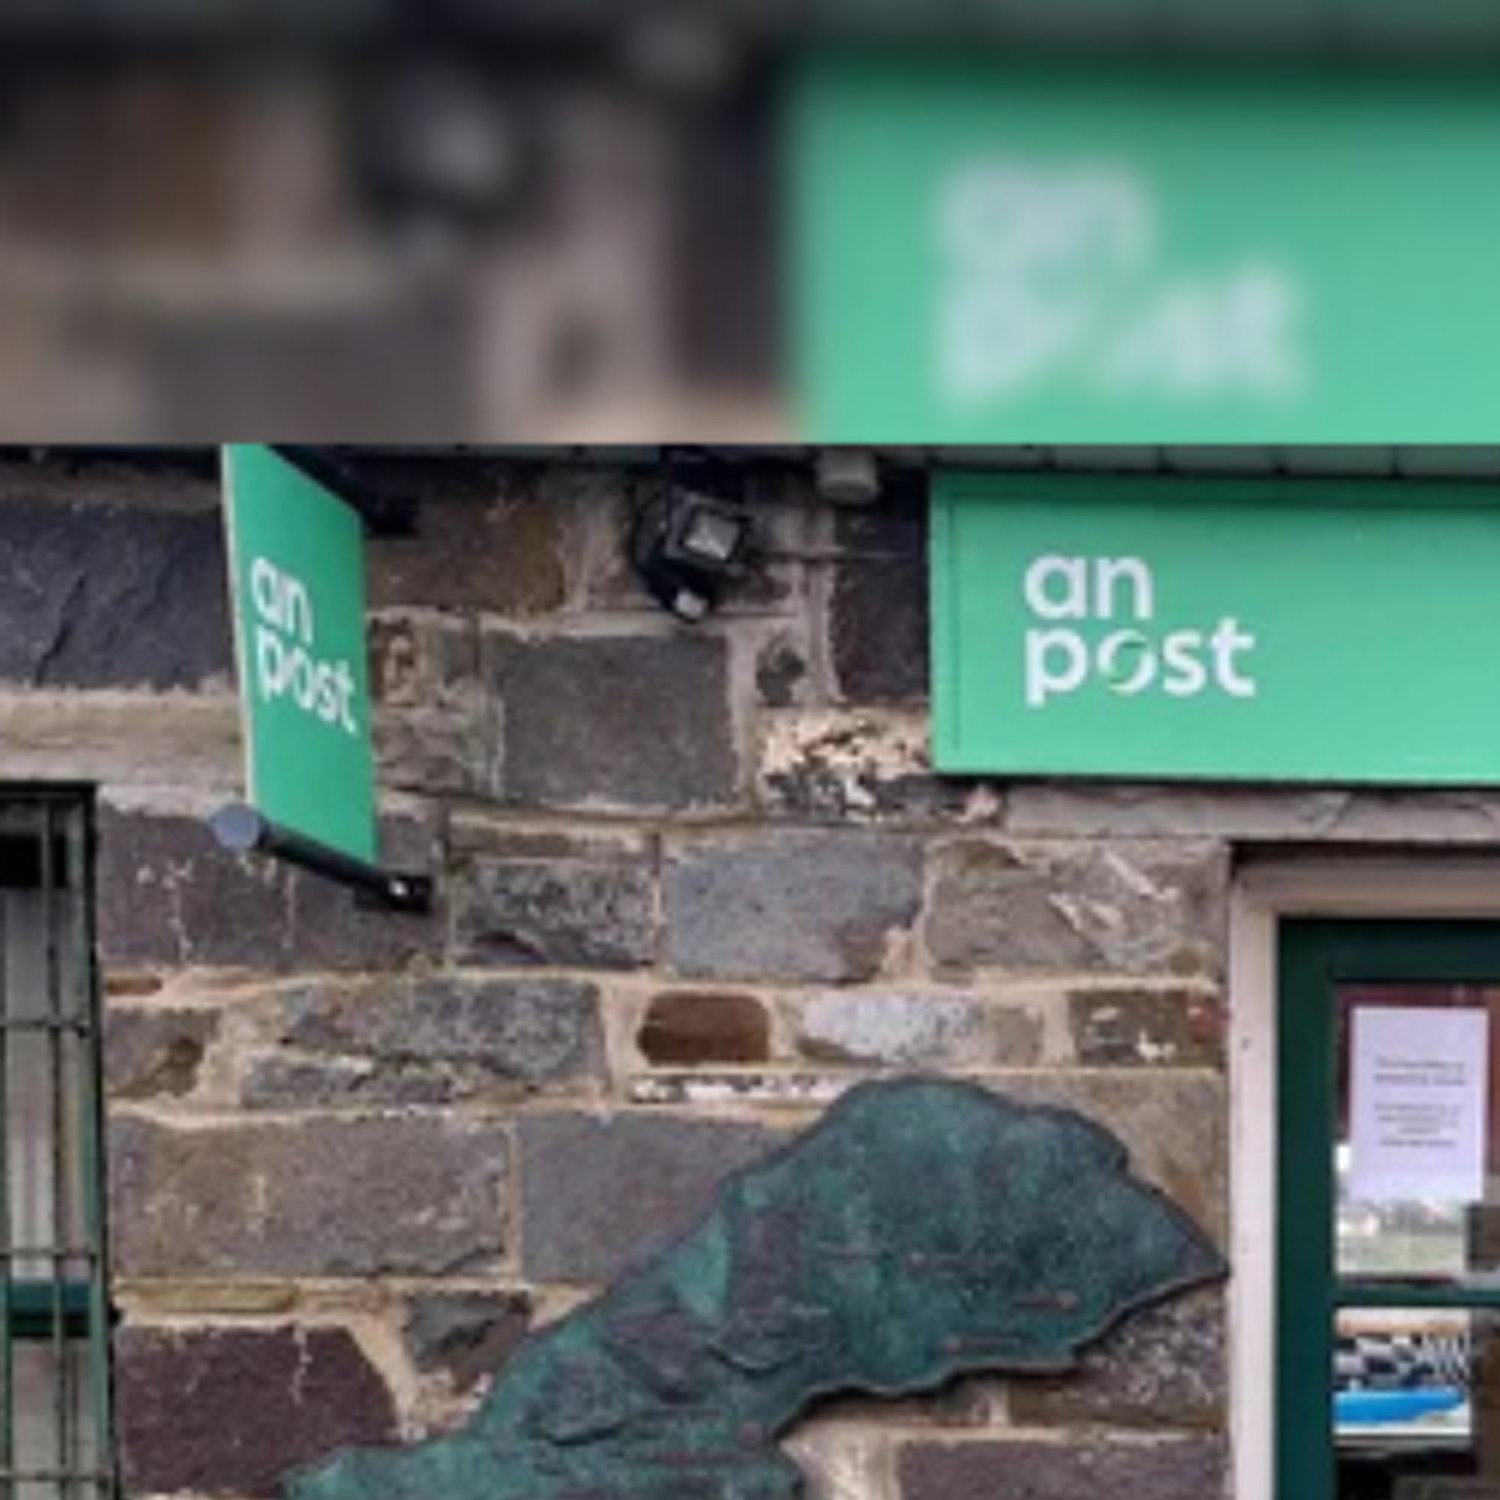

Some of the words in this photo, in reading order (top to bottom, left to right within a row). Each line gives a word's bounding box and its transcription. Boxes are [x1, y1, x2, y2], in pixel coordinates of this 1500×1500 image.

[253, 557, 314, 645] an
[1025, 555, 1153, 619] an
[257, 624, 358, 735] post
[1025, 617, 1256, 707] post
